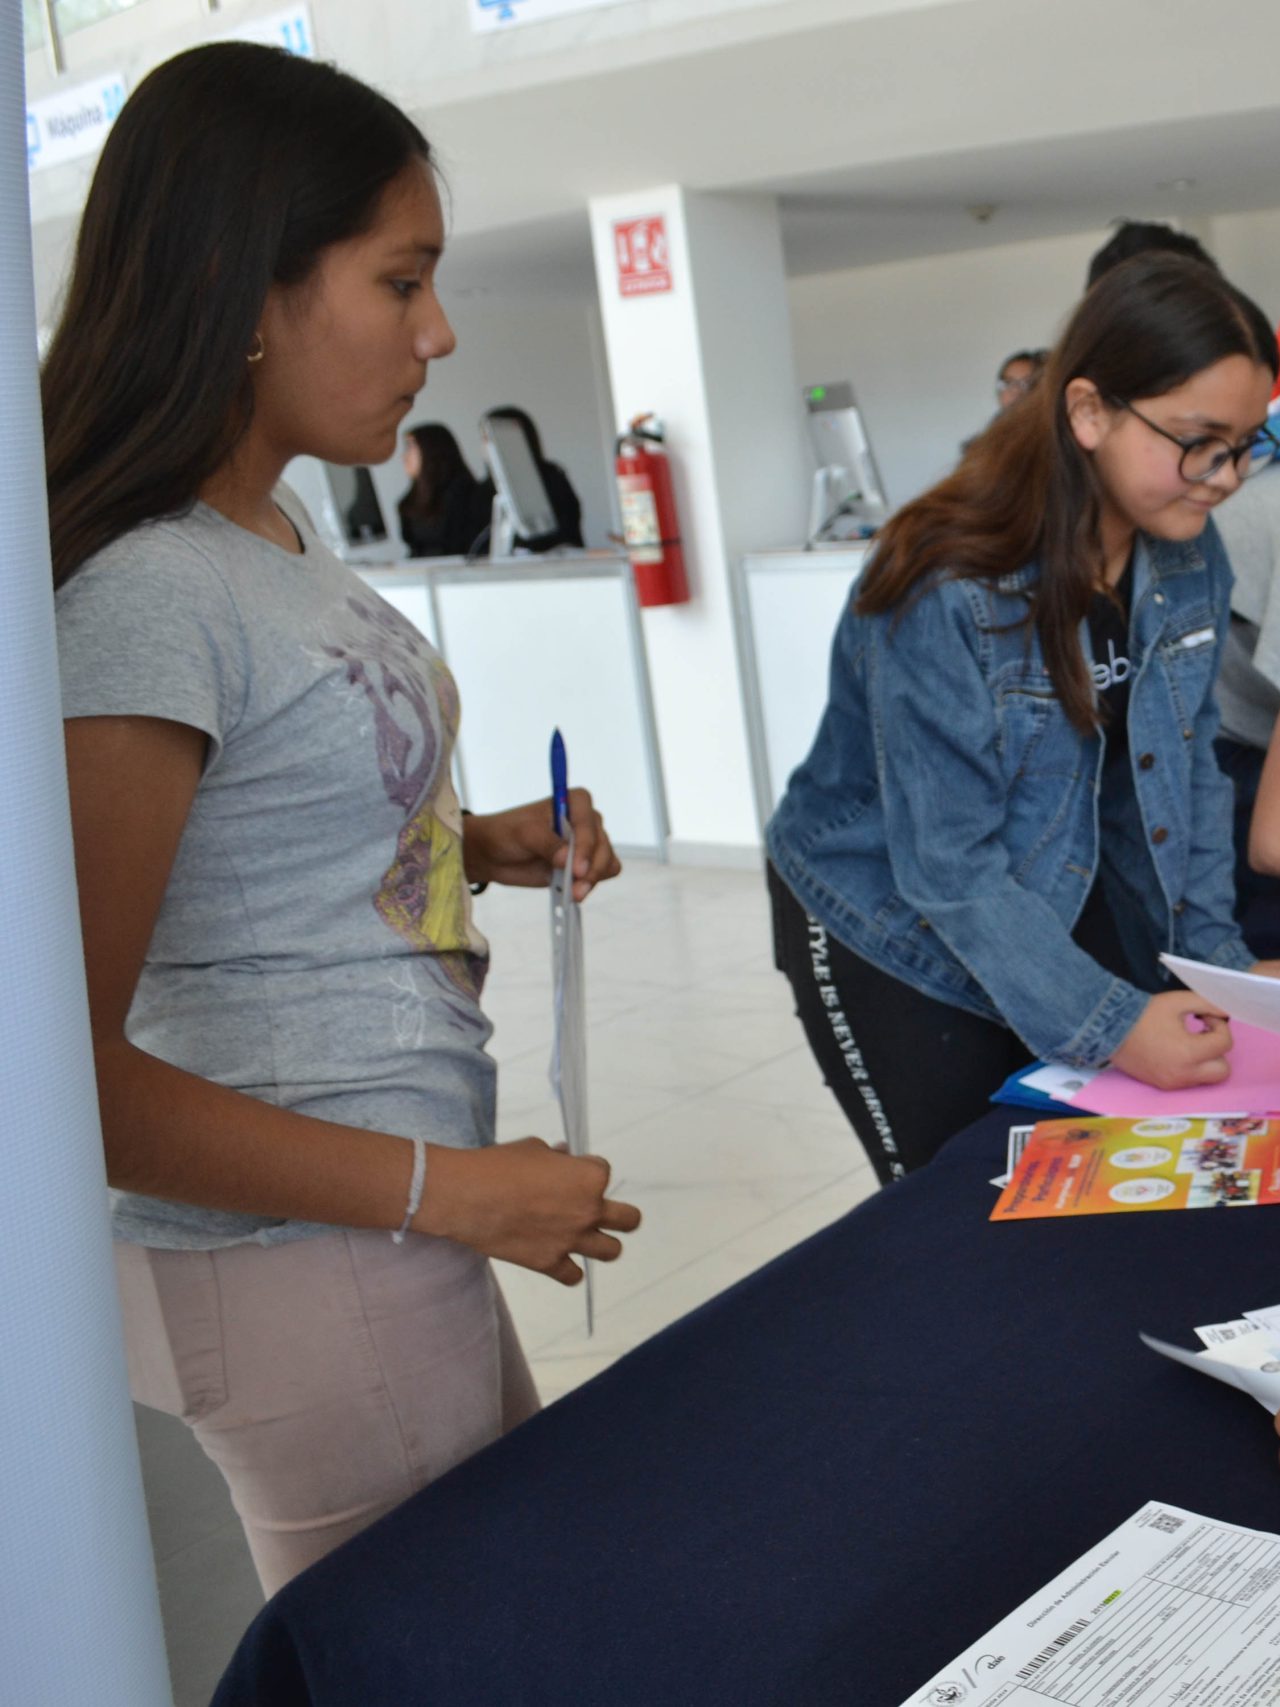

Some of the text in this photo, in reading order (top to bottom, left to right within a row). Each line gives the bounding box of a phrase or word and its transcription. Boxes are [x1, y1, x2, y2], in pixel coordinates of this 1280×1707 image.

[820, 985, 839, 1008] IS
[828, 1011, 868, 1081] NEVER
[889, 1161, 906, 1182] S
[1026, 1605, 1056, 1628] Dirección
[1060, 1567, 1101, 1600] Administración
[987, 1656, 1006, 1670] dae
